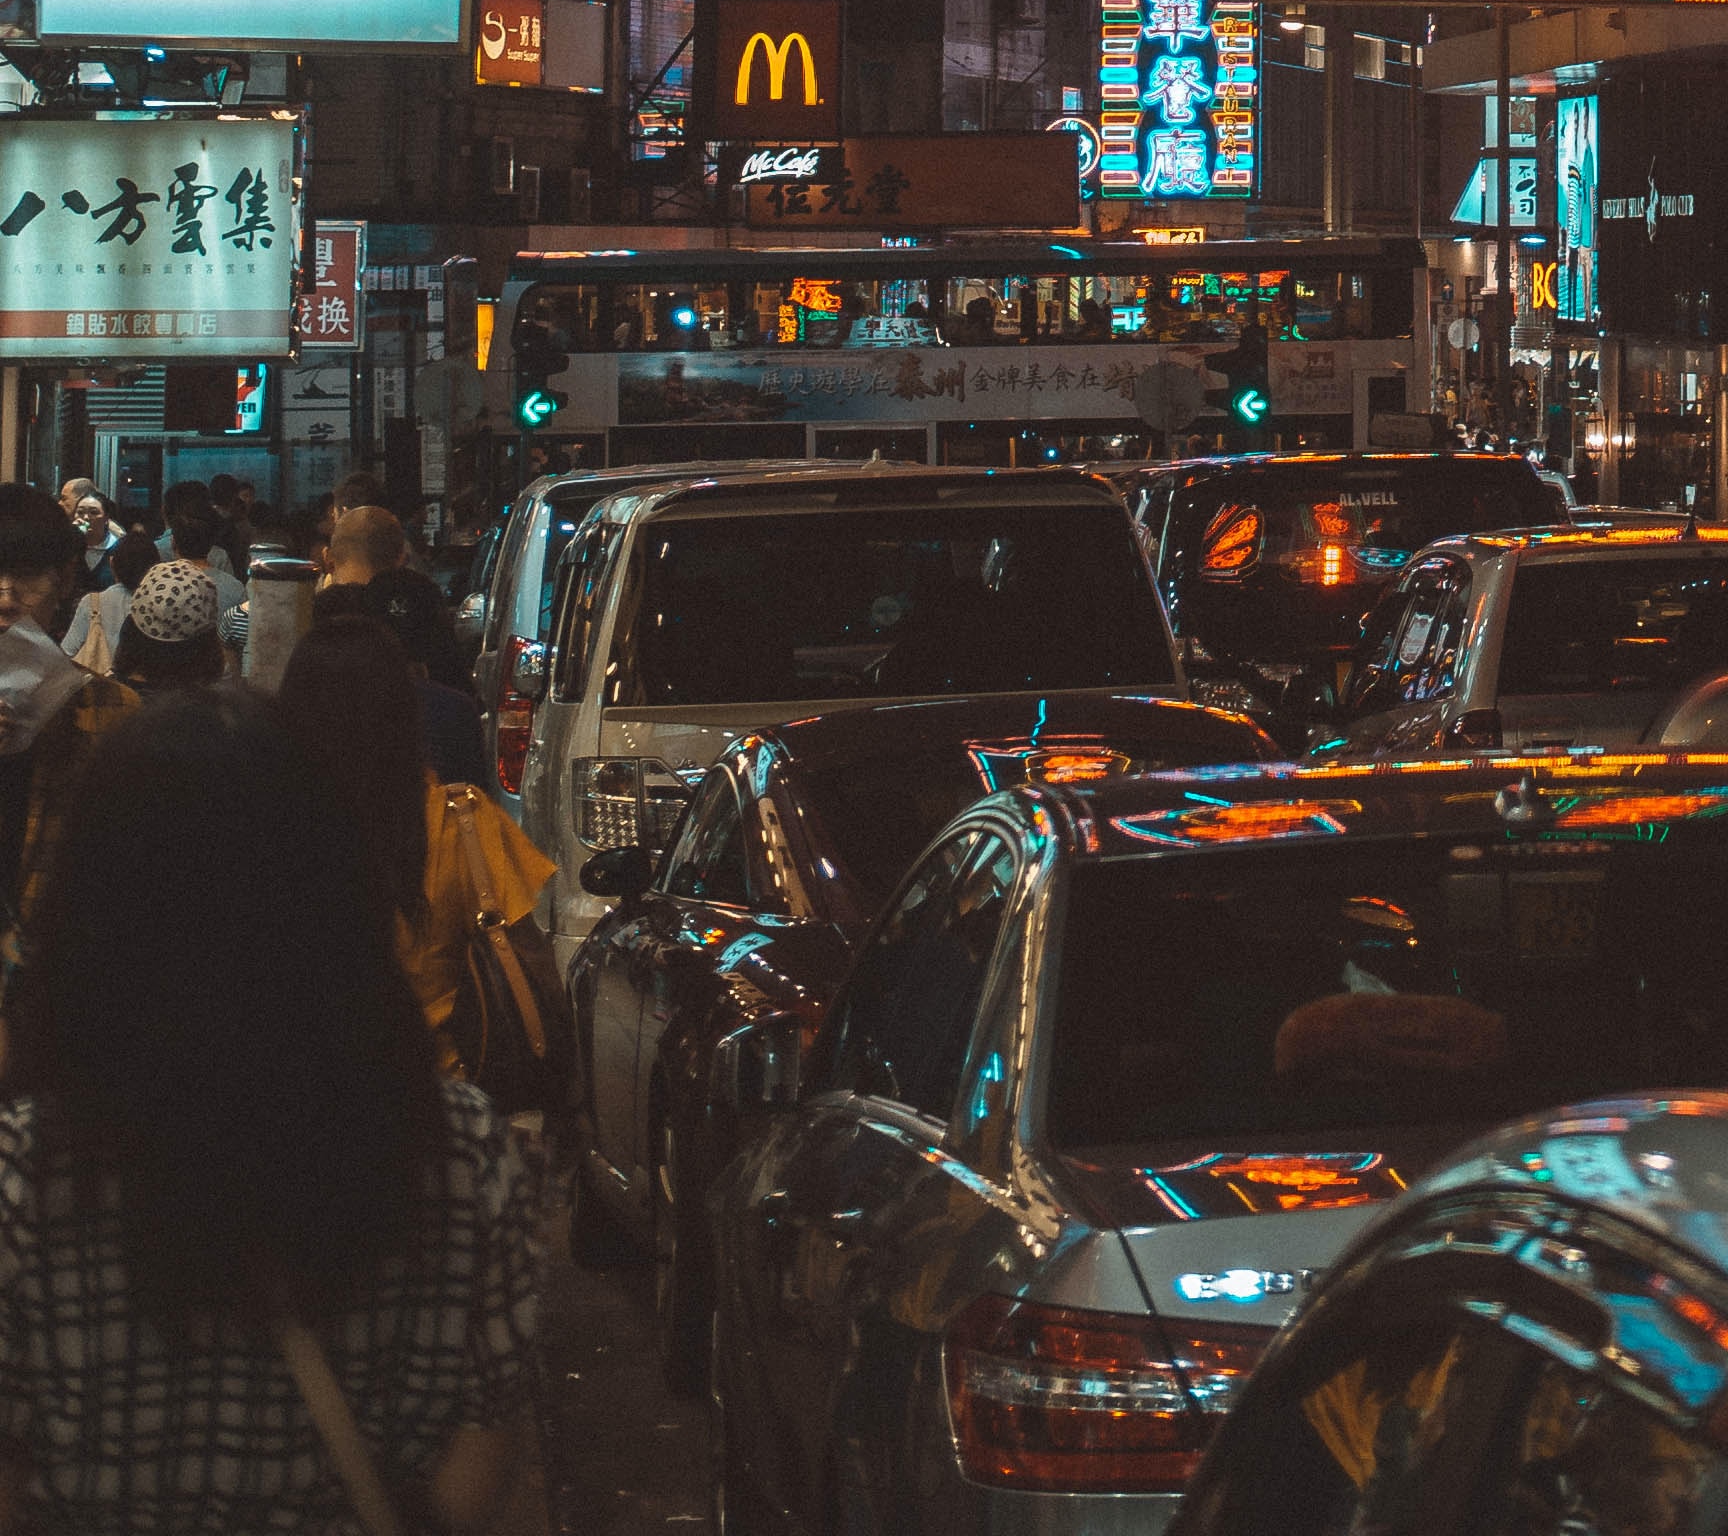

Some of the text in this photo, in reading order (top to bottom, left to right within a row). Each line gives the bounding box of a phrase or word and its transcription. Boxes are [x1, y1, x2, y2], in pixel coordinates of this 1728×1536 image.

[1223, 16, 1240, 182] RESTAURANT
[0, 161, 276, 256] 八方雲集
[1628, 197, 1645, 218] HILLS
[1661, 195, 1677, 216] POLO
[1678, 194, 1694, 216] CLUB
